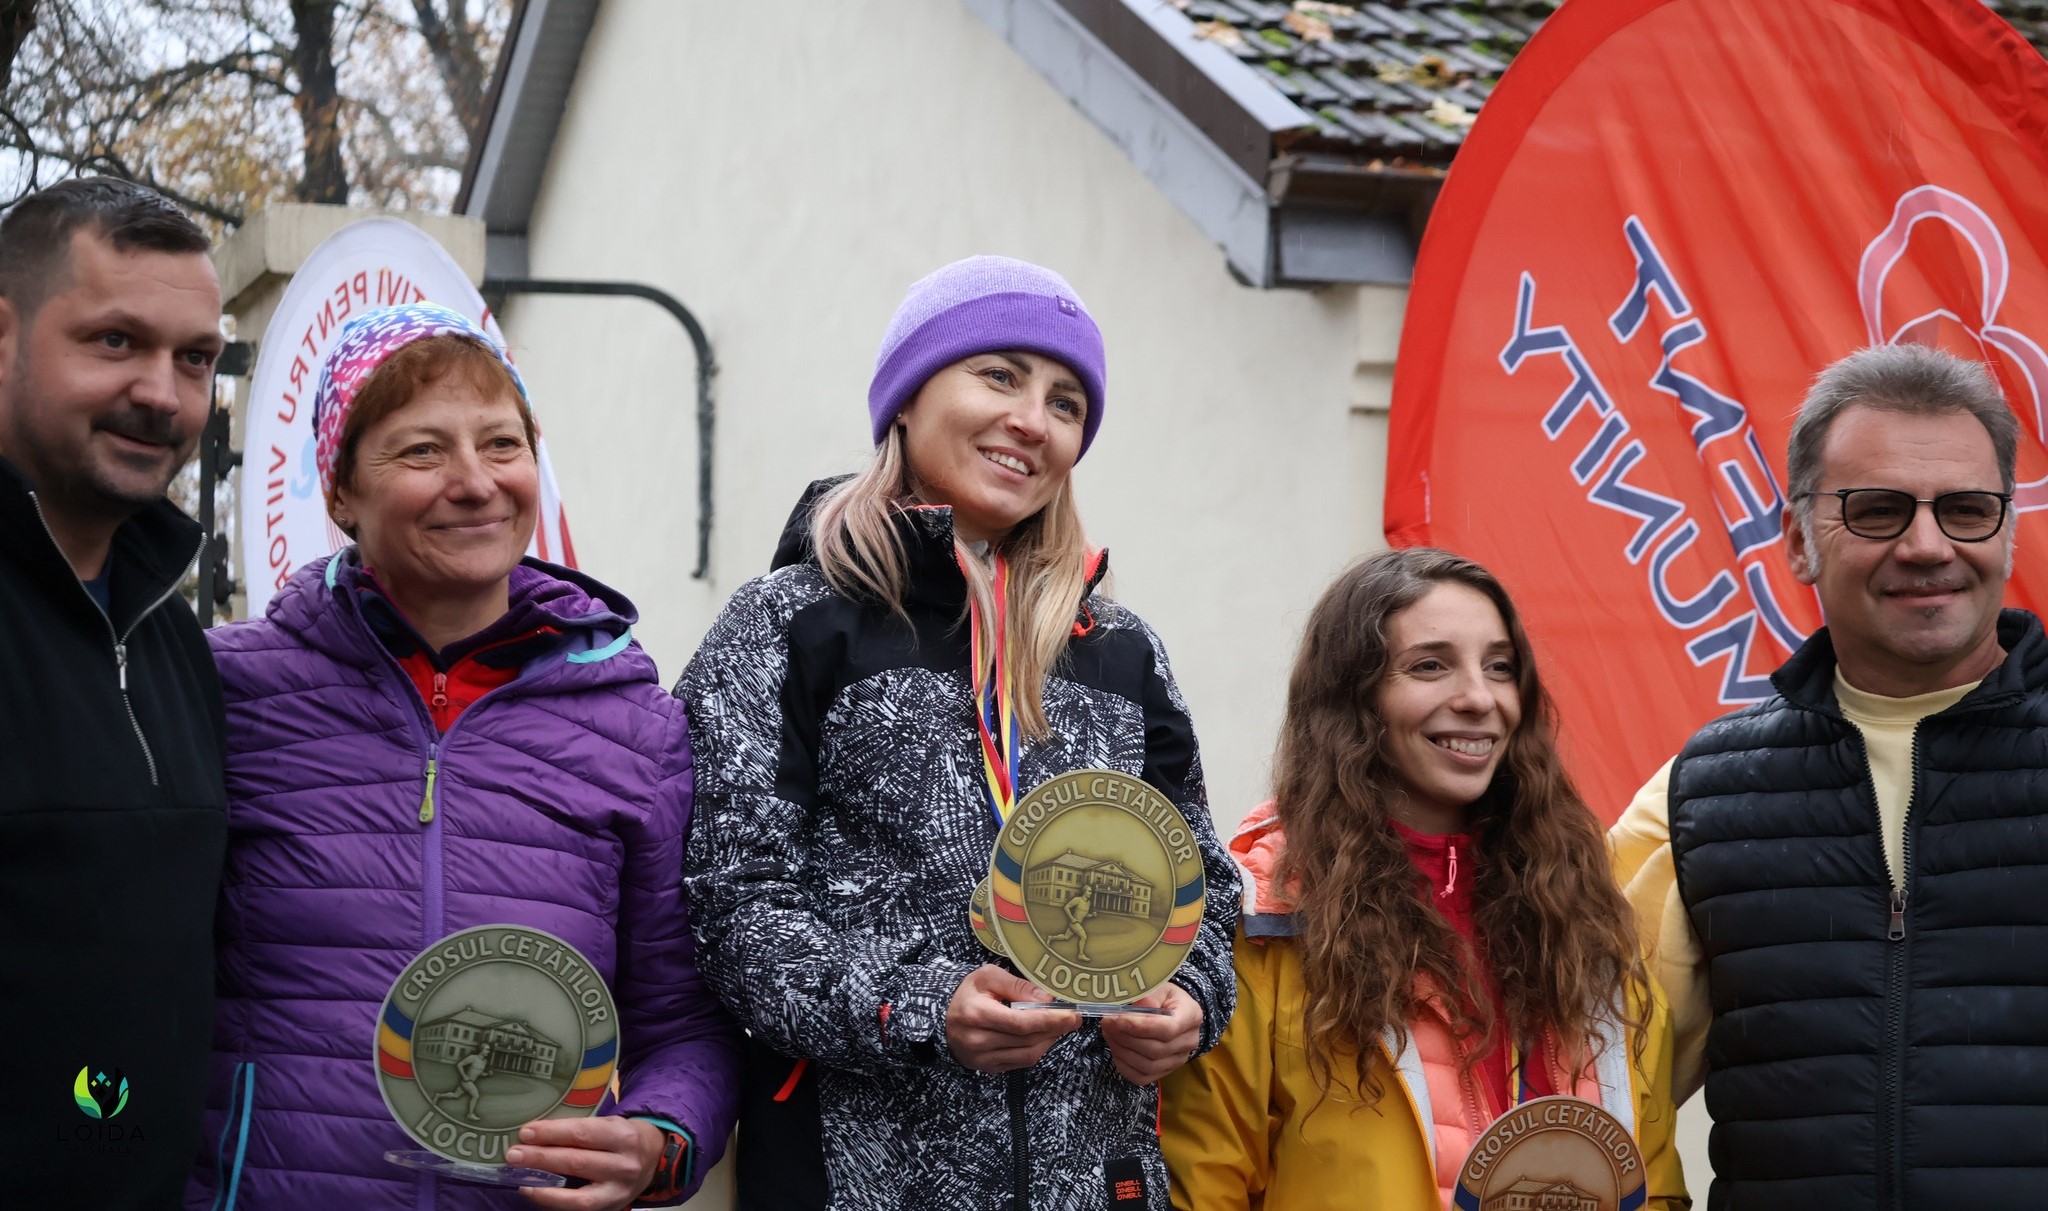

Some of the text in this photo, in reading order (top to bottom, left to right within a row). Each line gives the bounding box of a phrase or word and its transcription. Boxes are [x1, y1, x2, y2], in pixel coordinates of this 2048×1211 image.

[1008, 778, 1193, 865] CROSUL CETĂȚILOR
[975, 883, 989, 902] CRO
[402, 934, 609, 1026] CROSUL CETĂȚILOR
[1034, 953, 1146, 999] LOCUL 1
[1468, 1105, 1637, 1181] CROSUL CETĂȚILOR
